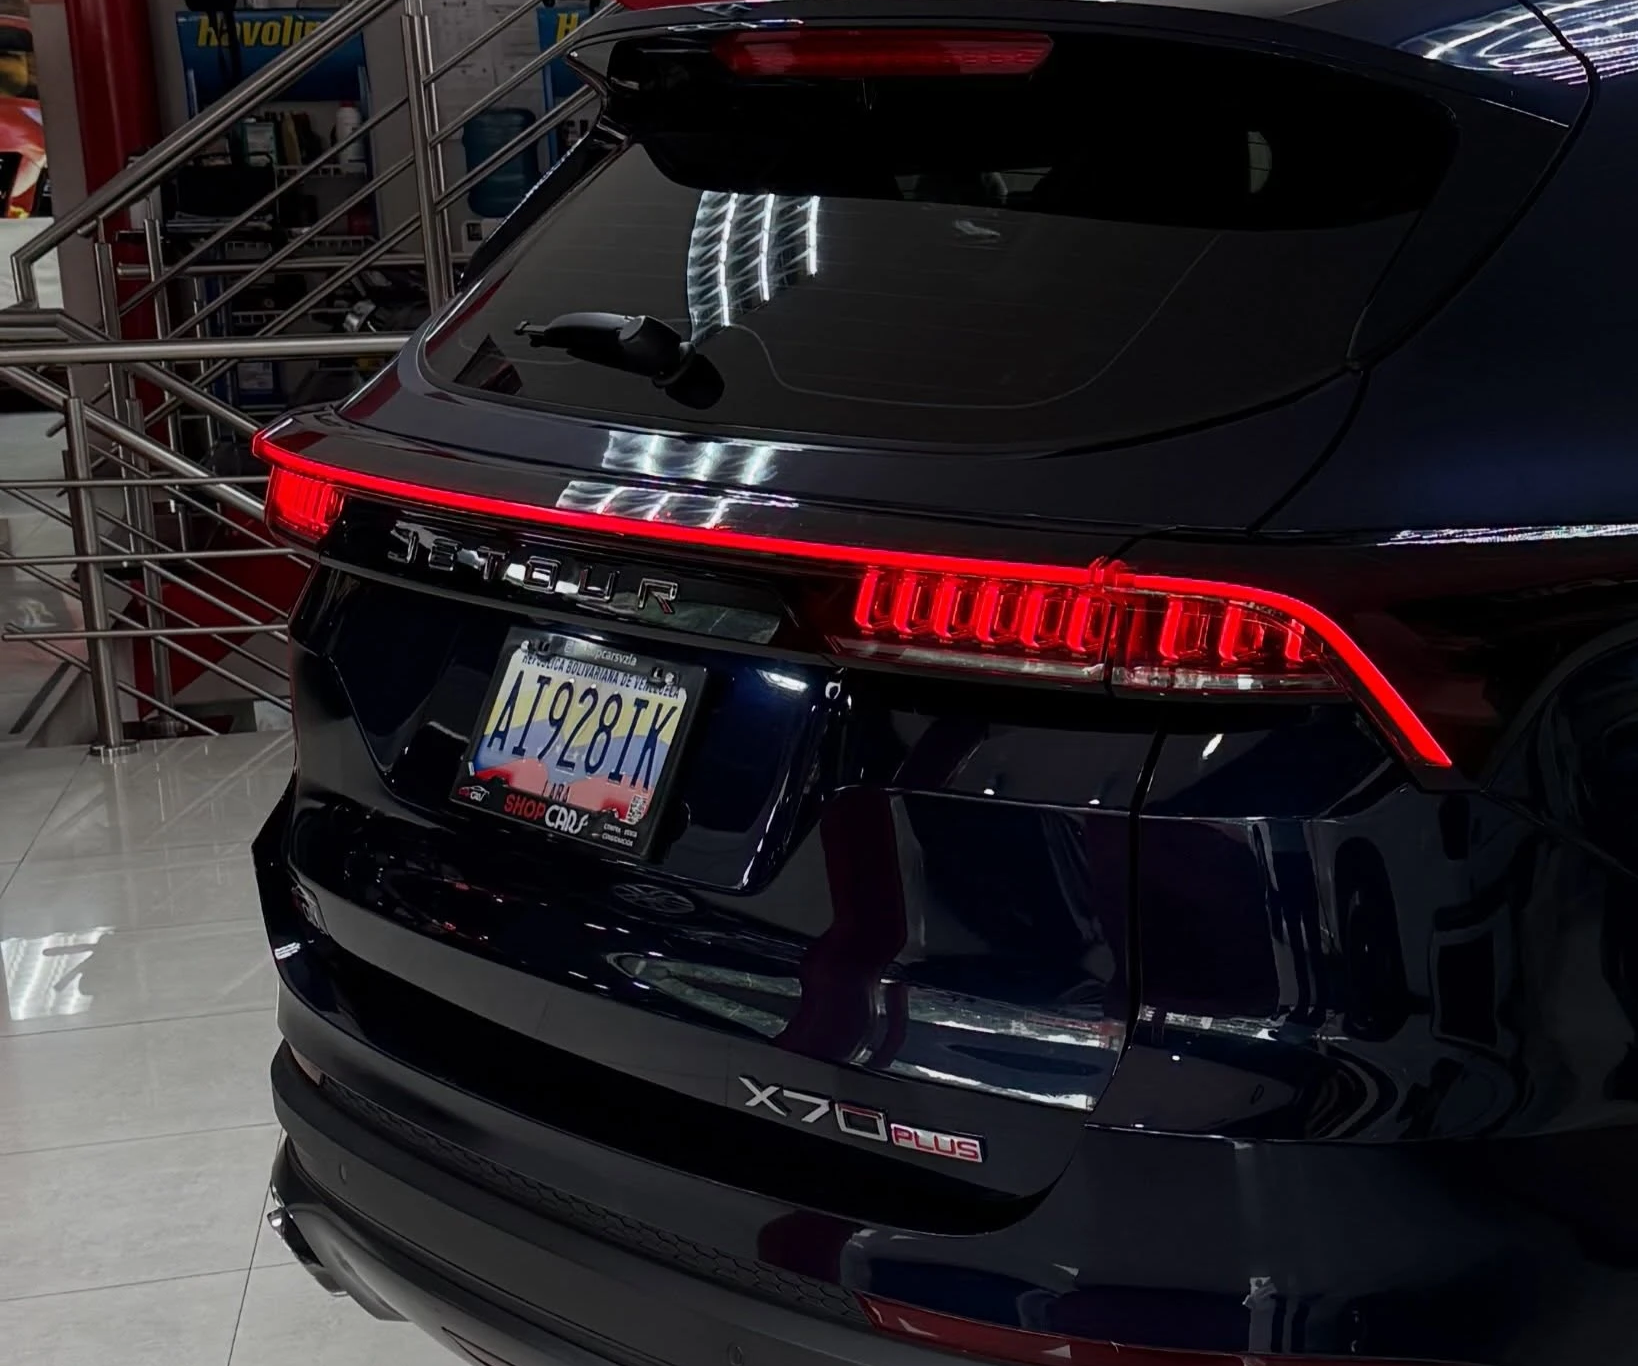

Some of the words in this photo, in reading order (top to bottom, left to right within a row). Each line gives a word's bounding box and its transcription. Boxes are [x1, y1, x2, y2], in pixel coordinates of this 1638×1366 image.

[388, 525, 679, 615] JETOUR
[566, 659, 618, 685] BOLIVARIANA
[620, 672, 632, 688] DE
[583, 644, 638, 667] pcarsvzla
[487, 670, 678, 791] AI928IK
[738, 1075, 889, 1143] X70
[892, 1126, 980, 1161] PLUS
